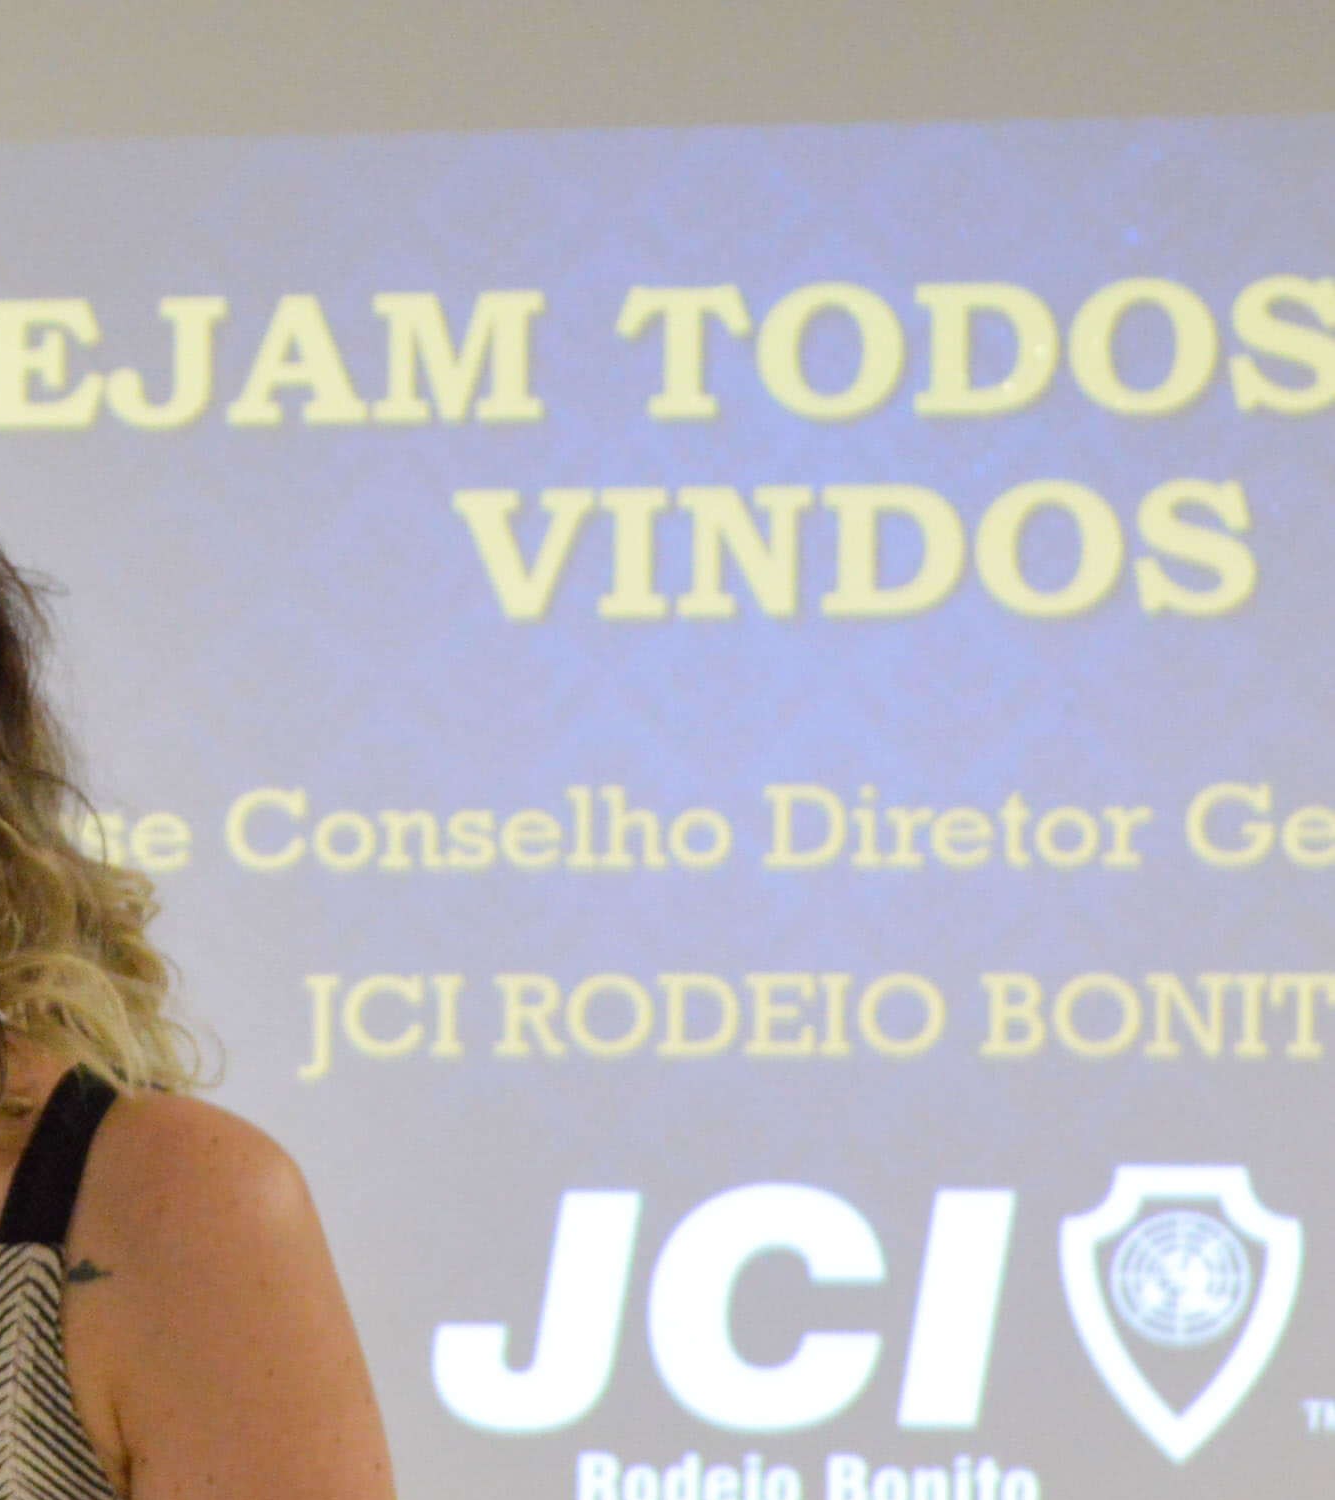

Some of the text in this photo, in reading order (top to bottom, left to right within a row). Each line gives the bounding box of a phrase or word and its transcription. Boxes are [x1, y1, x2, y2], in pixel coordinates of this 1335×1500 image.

[618, 274, 1335, 420] TODOS
[455, 480, 1260, 620] VINDOS
[225, 786, 731, 872] Conselho
[766, 785, 1152, 868] Diretor
[1187, 784, 1335, 868] Ge
[296, 971, 1335, 1084] JCI RODEIO BONIT
[430, 1180, 1018, 1434] JCI
